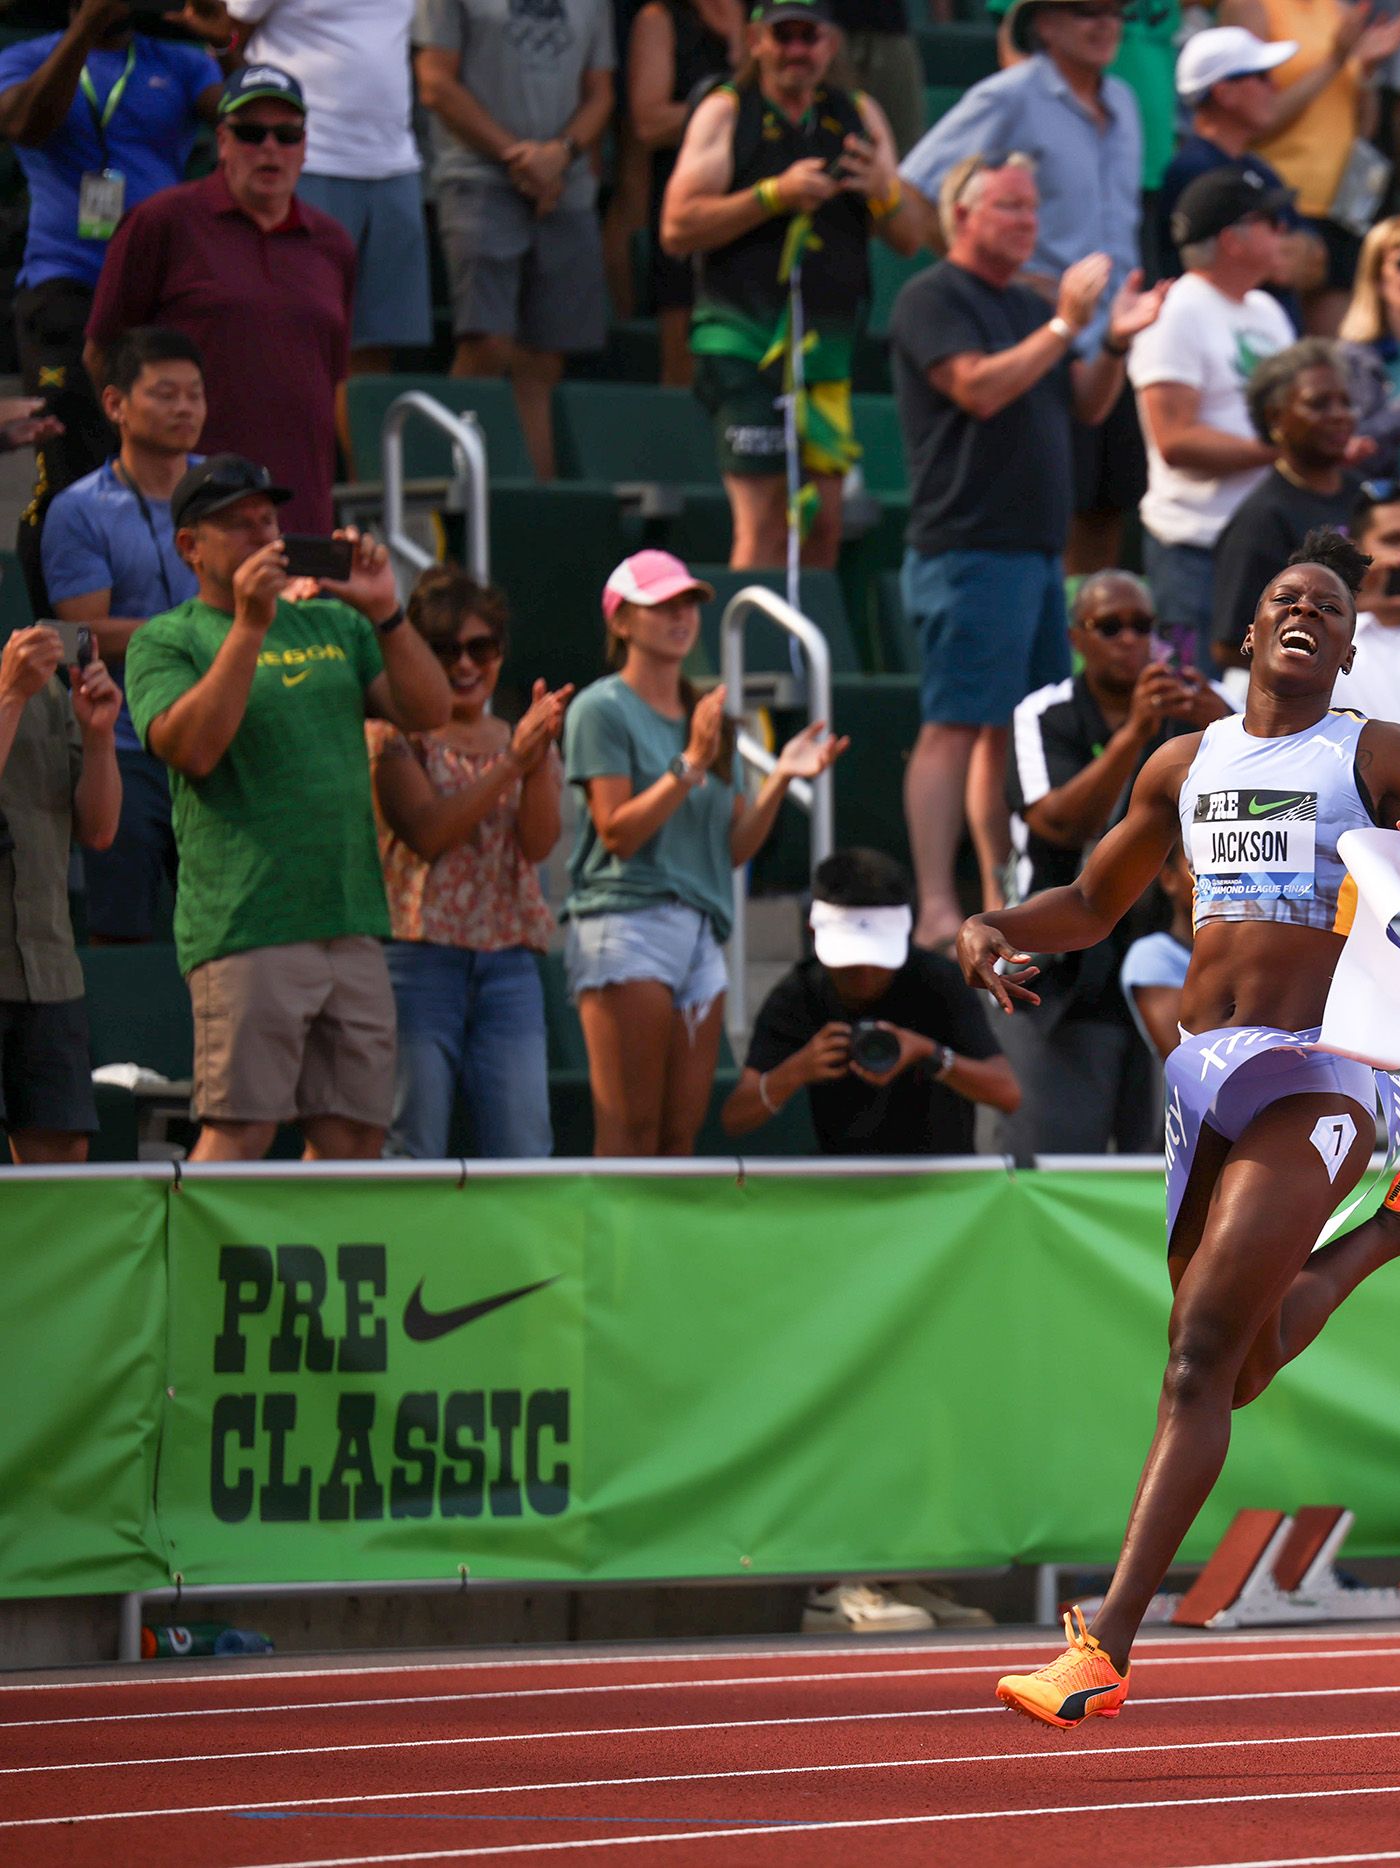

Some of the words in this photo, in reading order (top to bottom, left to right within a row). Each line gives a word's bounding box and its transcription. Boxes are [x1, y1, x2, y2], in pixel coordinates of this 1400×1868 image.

[257, 644, 346, 667] EGON
[1206, 791, 1239, 820] PRE
[1211, 831, 1288, 863] JACKSON
[1245, 884, 1282, 894] LEAGUE
[1333, 1124, 1343, 1156] 7
[213, 1243, 388, 1374] PRE
[210, 1388, 571, 1524] CLASSIC
